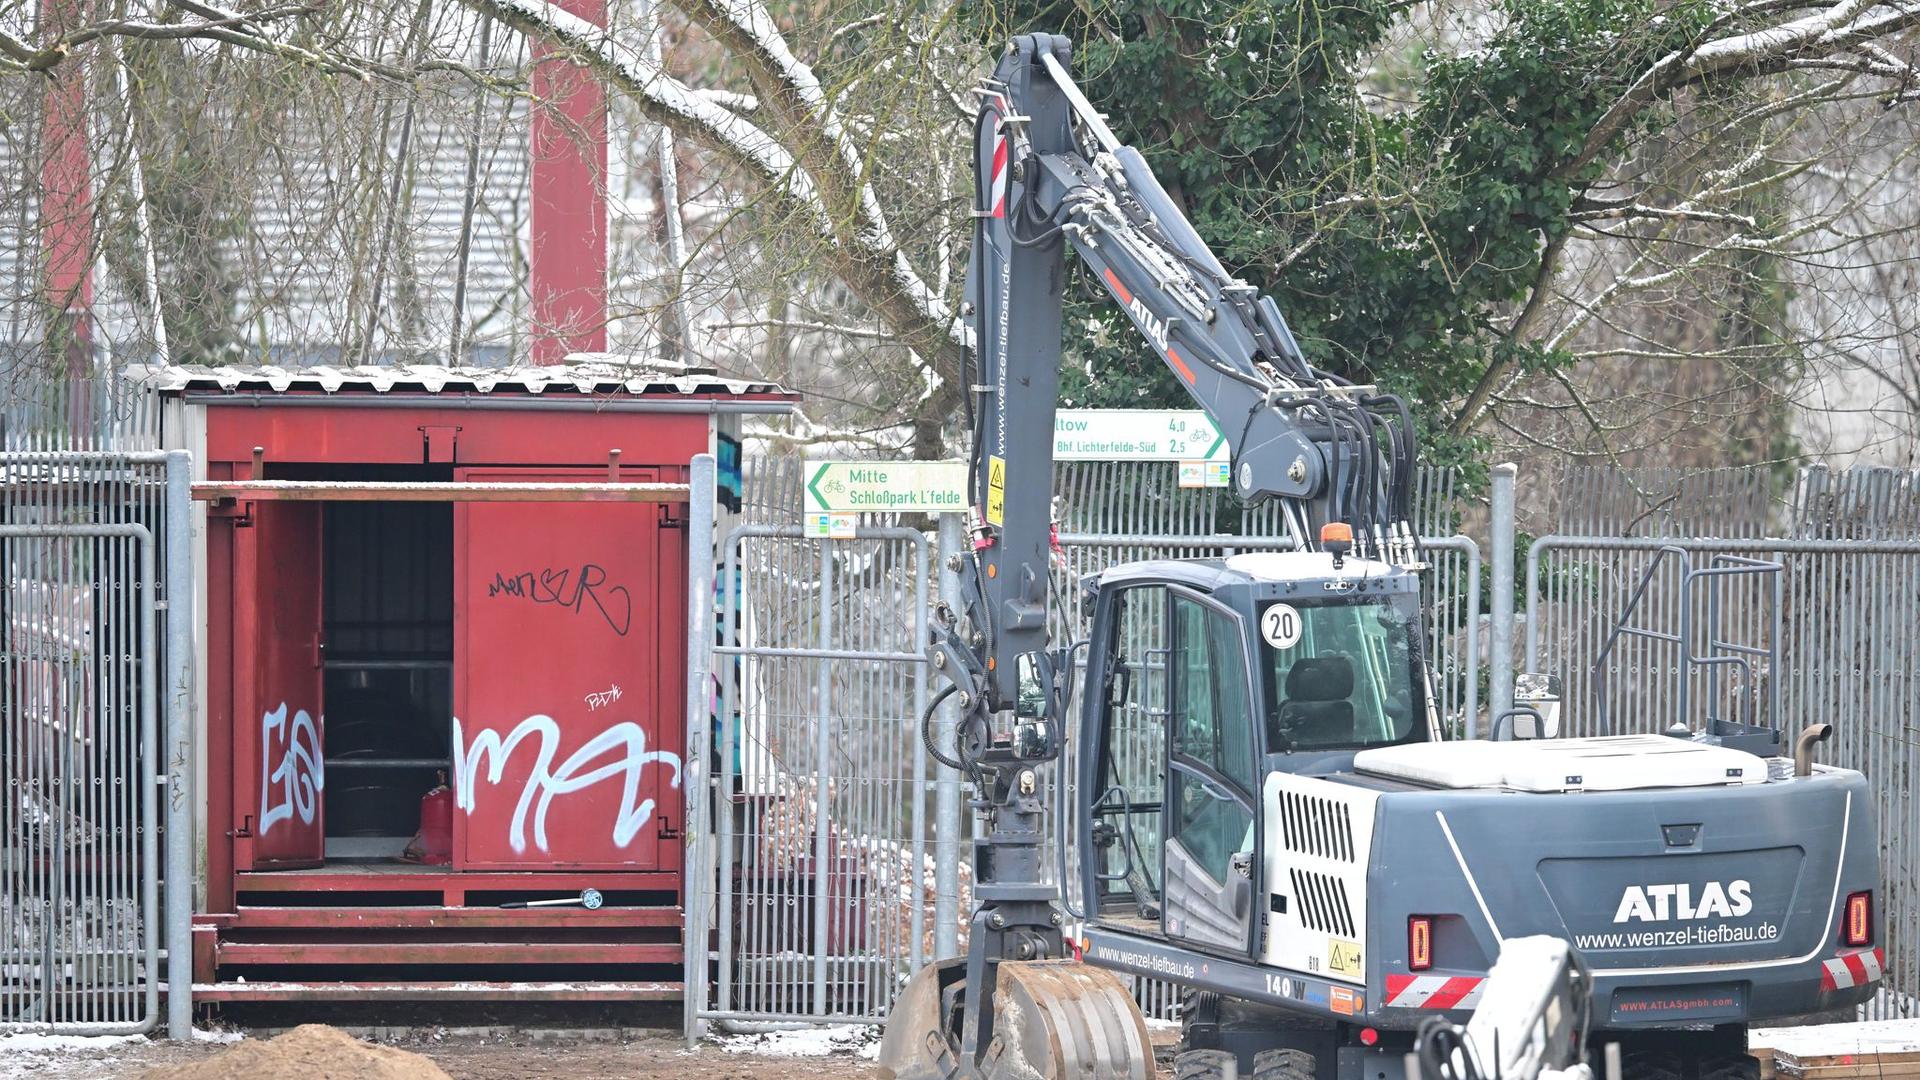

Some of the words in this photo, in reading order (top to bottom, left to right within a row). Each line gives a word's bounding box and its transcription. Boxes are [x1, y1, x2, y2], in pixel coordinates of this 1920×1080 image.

[1130, 297, 1168, 351] ATLAS
[998, 263, 1010, 455] www.wenzel-tiefbau.de
[1055, 418, 1088, 431] ltow
[1169, 418, 1186, 433] 4.0
[1057, 441, 1075, 453] Bhf.
[1077, 441, 1156, 453] Lichterfelde-Süd
[1169, 439, 1186, 453] 2.5
[849, 469, 888, 484] Mitte
[849, 490, 917, 508] Schloßpark
[1270, 613, 1293, 639] 20
[1613, 879, 1753, 923] ATLAS
[1575, 921, 1778, 949] www.wenzel-tiefbau.de
[1098, 946, 1195, 979] www.wenzel-tiefbau.de
[1265, 974, 1291, 998] 140
[1293, 979, 1306, 1000] W
